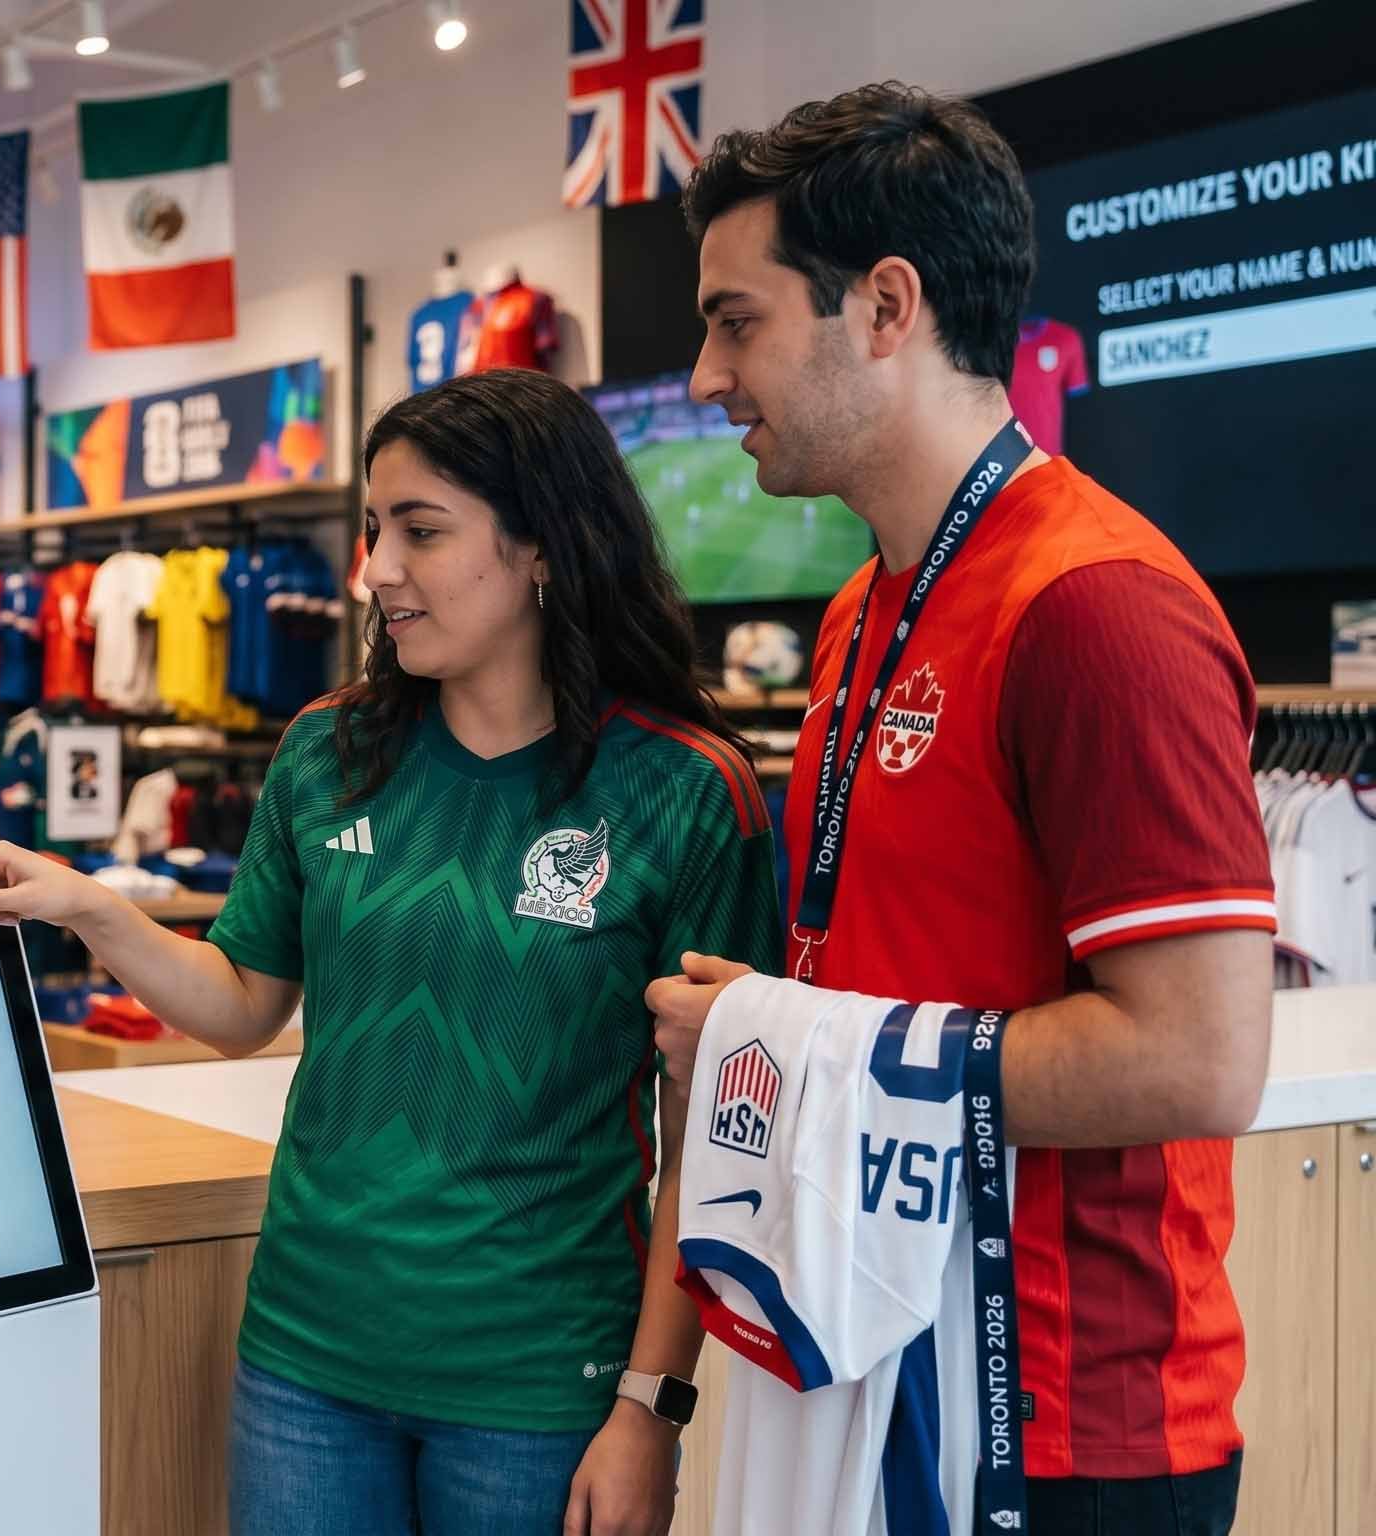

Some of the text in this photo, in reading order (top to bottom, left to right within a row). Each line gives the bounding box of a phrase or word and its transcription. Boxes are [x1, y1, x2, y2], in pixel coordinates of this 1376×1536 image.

[1066, 139, 1376, 242] CUSTOMIZE YOUR KI
[1098, 272, 1173, 315] SELECT
[1175, 262, 1236, 301] YOUR
[1238, 249, 1305, 290] NAME
[1307, 246, 1326, 279] &
[1107, 328, 1211, 369] SANCHEZ
[911, 461, 1003, 603] TORONTO 2026
[881, 710, 935, 735] CANADA
[985, 1294, 1011, 1470] TORONTO 2026
